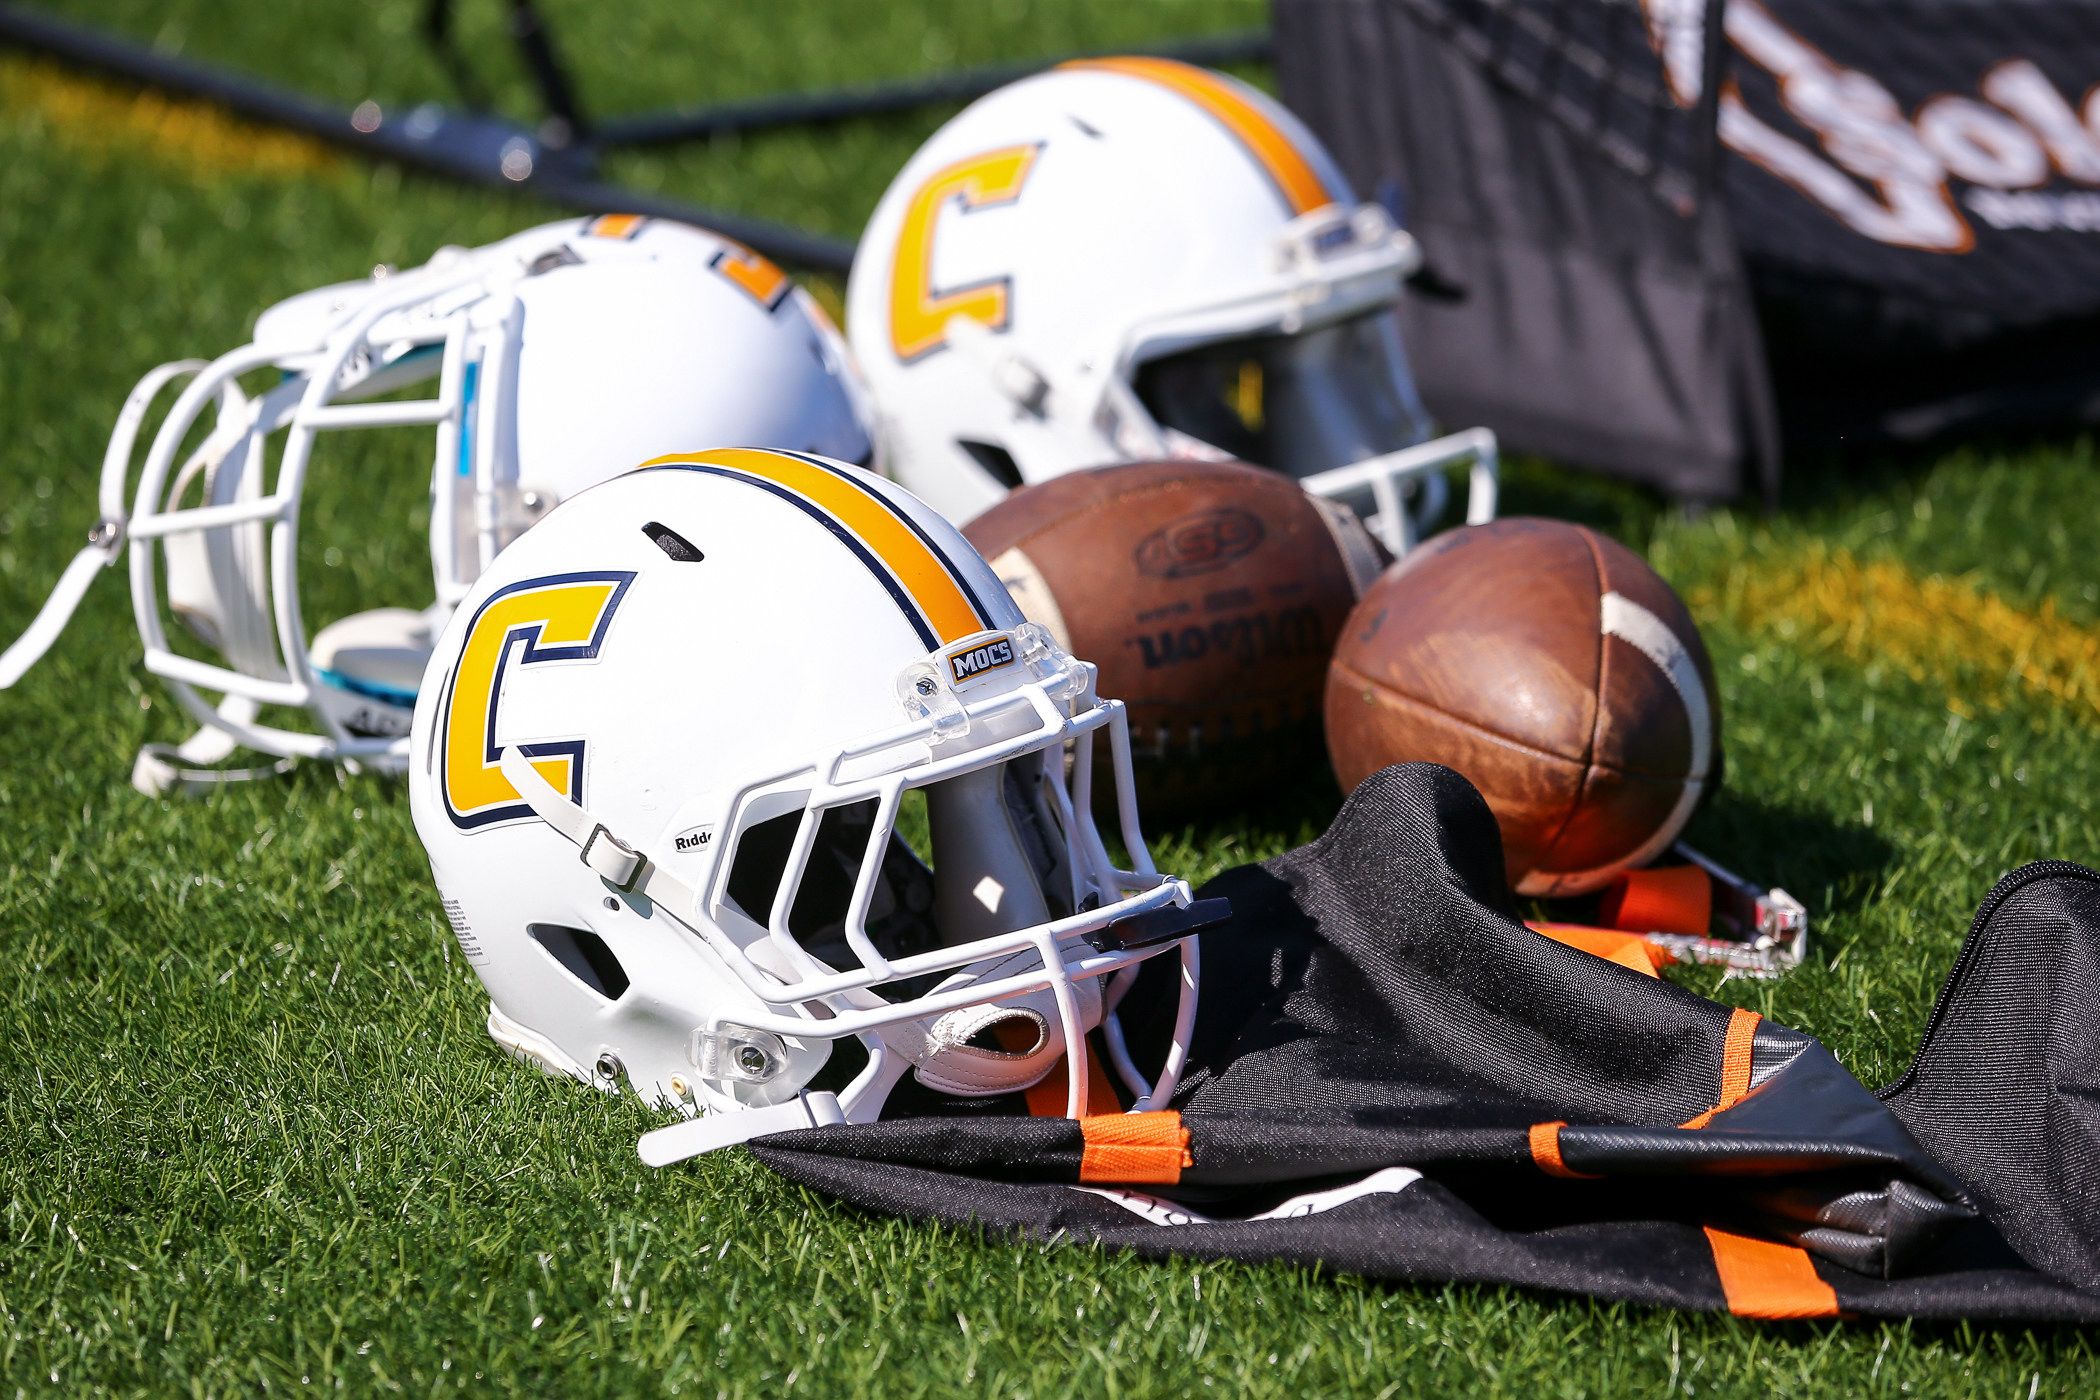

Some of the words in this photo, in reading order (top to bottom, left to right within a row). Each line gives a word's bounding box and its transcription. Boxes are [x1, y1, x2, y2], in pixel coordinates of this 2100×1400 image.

[887, 141, 1047, 367] C
[441, 570, 639, 830] C
[952, 641, 1013, 678] MOCS
